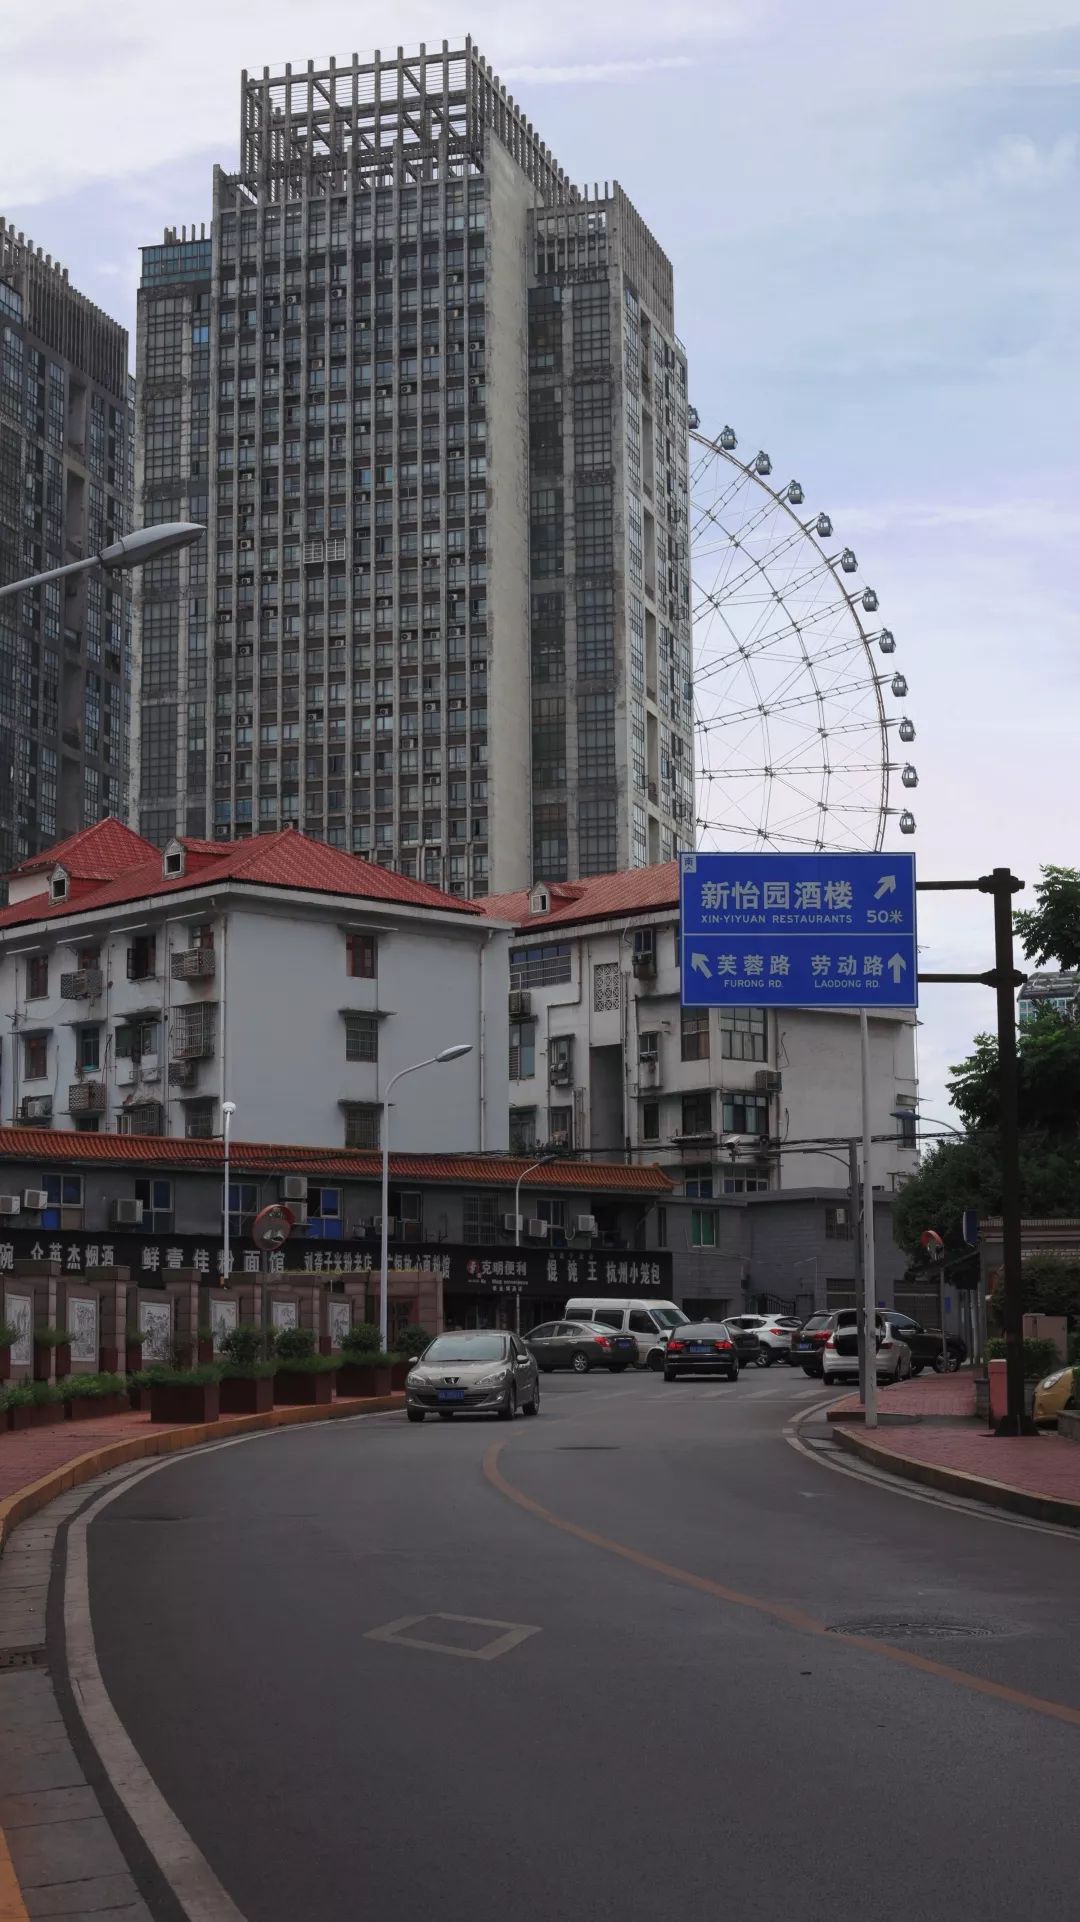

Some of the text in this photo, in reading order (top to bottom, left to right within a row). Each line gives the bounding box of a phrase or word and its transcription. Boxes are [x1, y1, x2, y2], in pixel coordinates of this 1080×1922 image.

[684, 857, 694, 866] 南
[701, 881, 852, 910] 新怡园酒楼
[701, 914, 853, 924] XIN-YIYUAN RESTAURANTS
[866, 909, 903, 924] 50米
[717, 954, 791, 976] 芙蓉路
[811, 954, 884, 976] 劳动路
[724, 979, 765, 988] FURONG
[814, 979, 862, 988] LAODONG
[481, 1259, 527, 1276] 克明便利
[606, 1260, 661, 1285] 杭州小笼包
